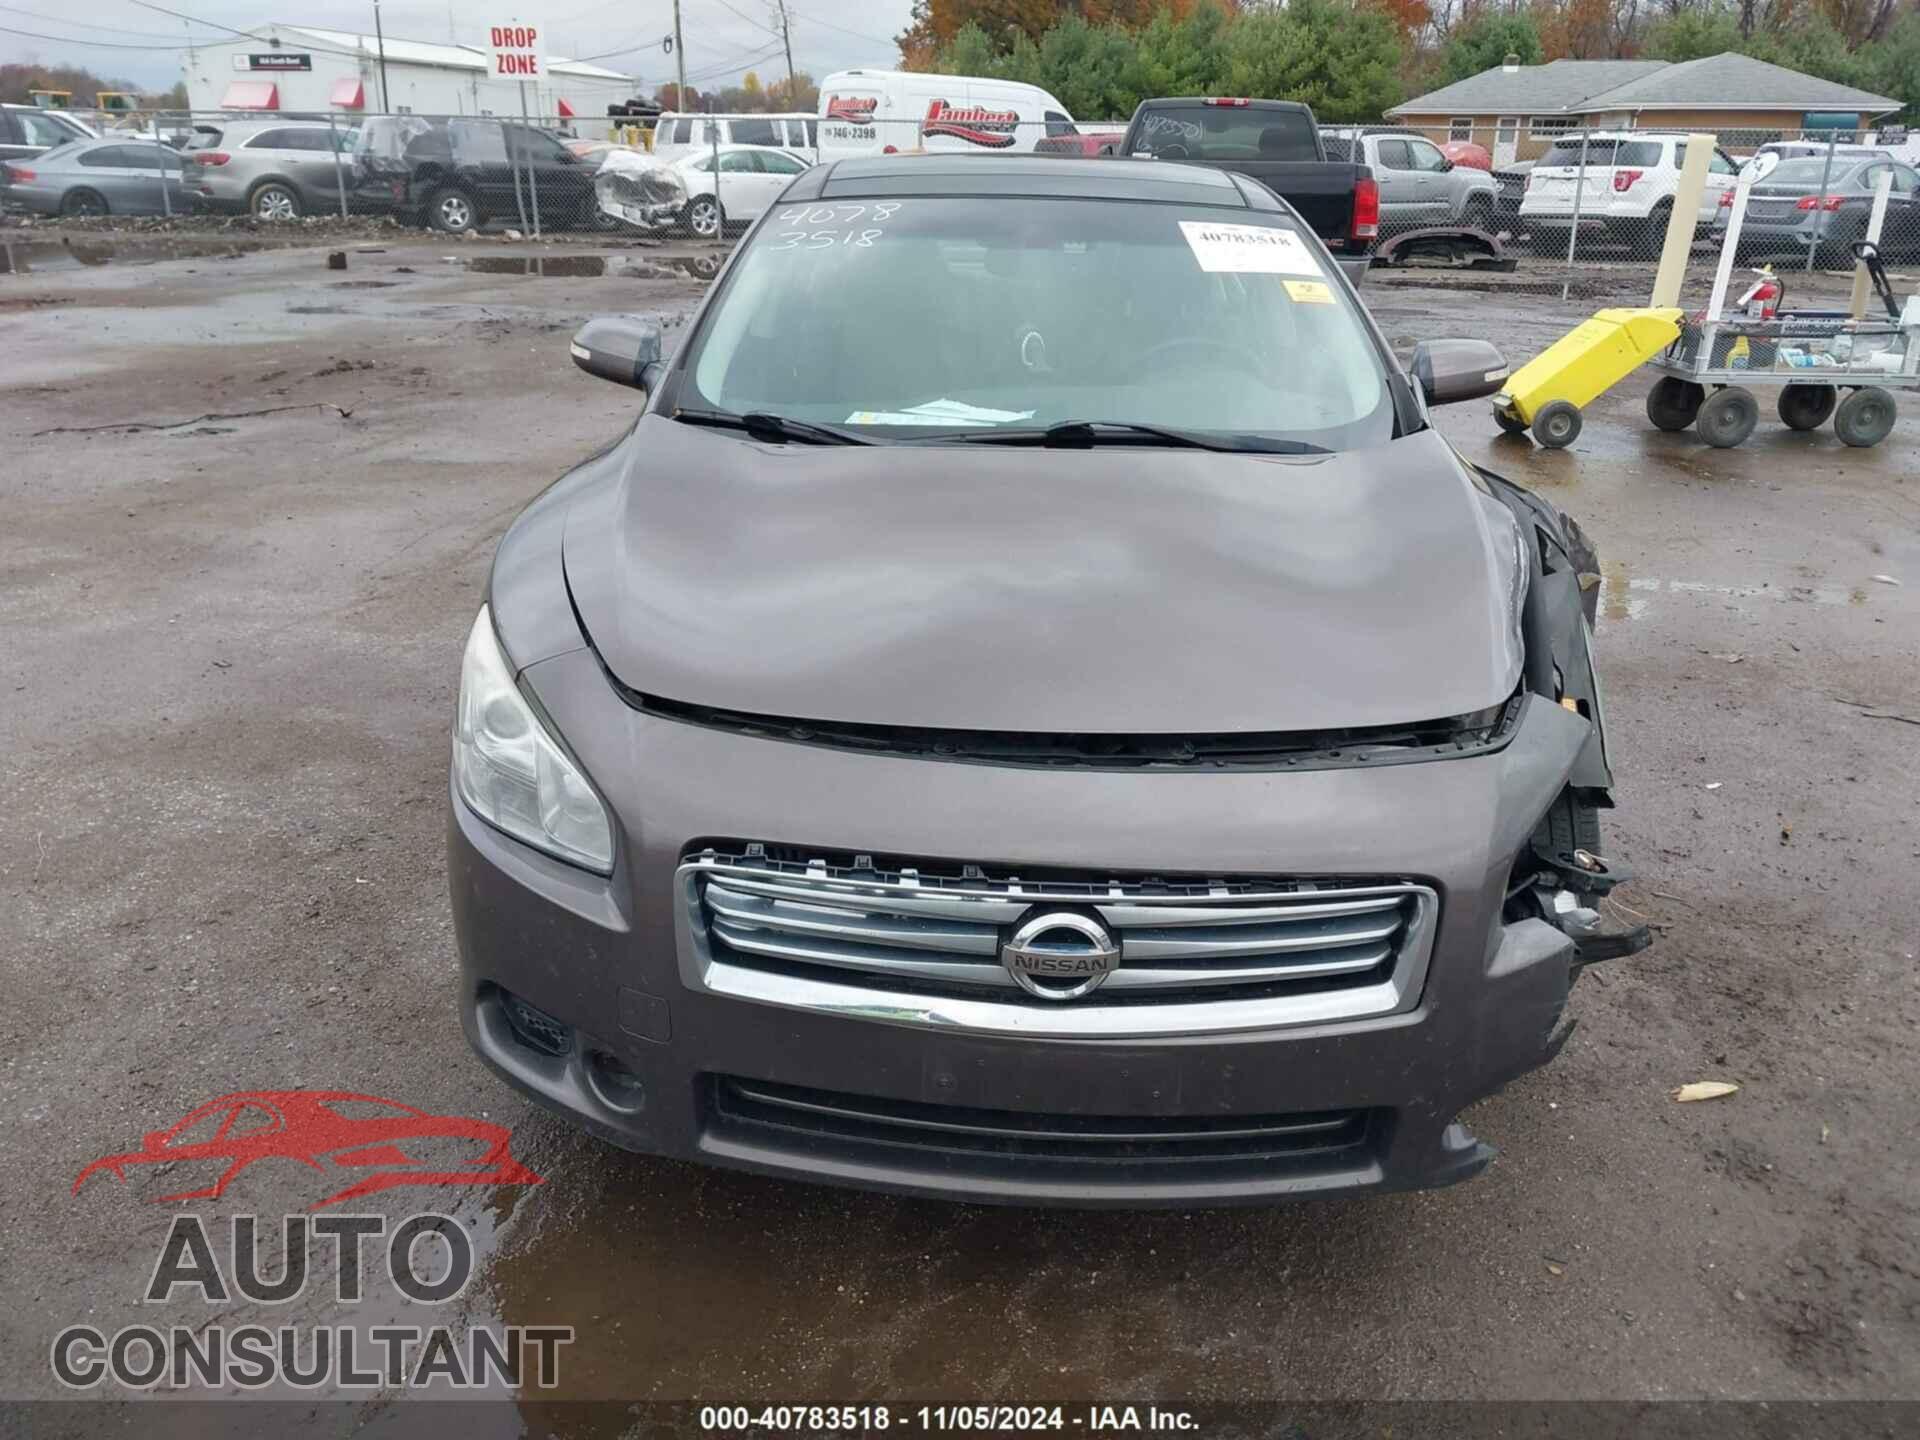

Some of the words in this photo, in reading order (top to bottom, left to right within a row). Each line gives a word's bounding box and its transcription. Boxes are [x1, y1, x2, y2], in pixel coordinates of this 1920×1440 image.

[491, 27, 537, 48] DROP
[496, 54, 538, 74] ZONE
[779, 202, 903, 227] 4078
[769, 228, 884, 251] 3518
[1200, 232, 1291, 247] 40783518
[1015, 955, 1108, 972] NISSAN
